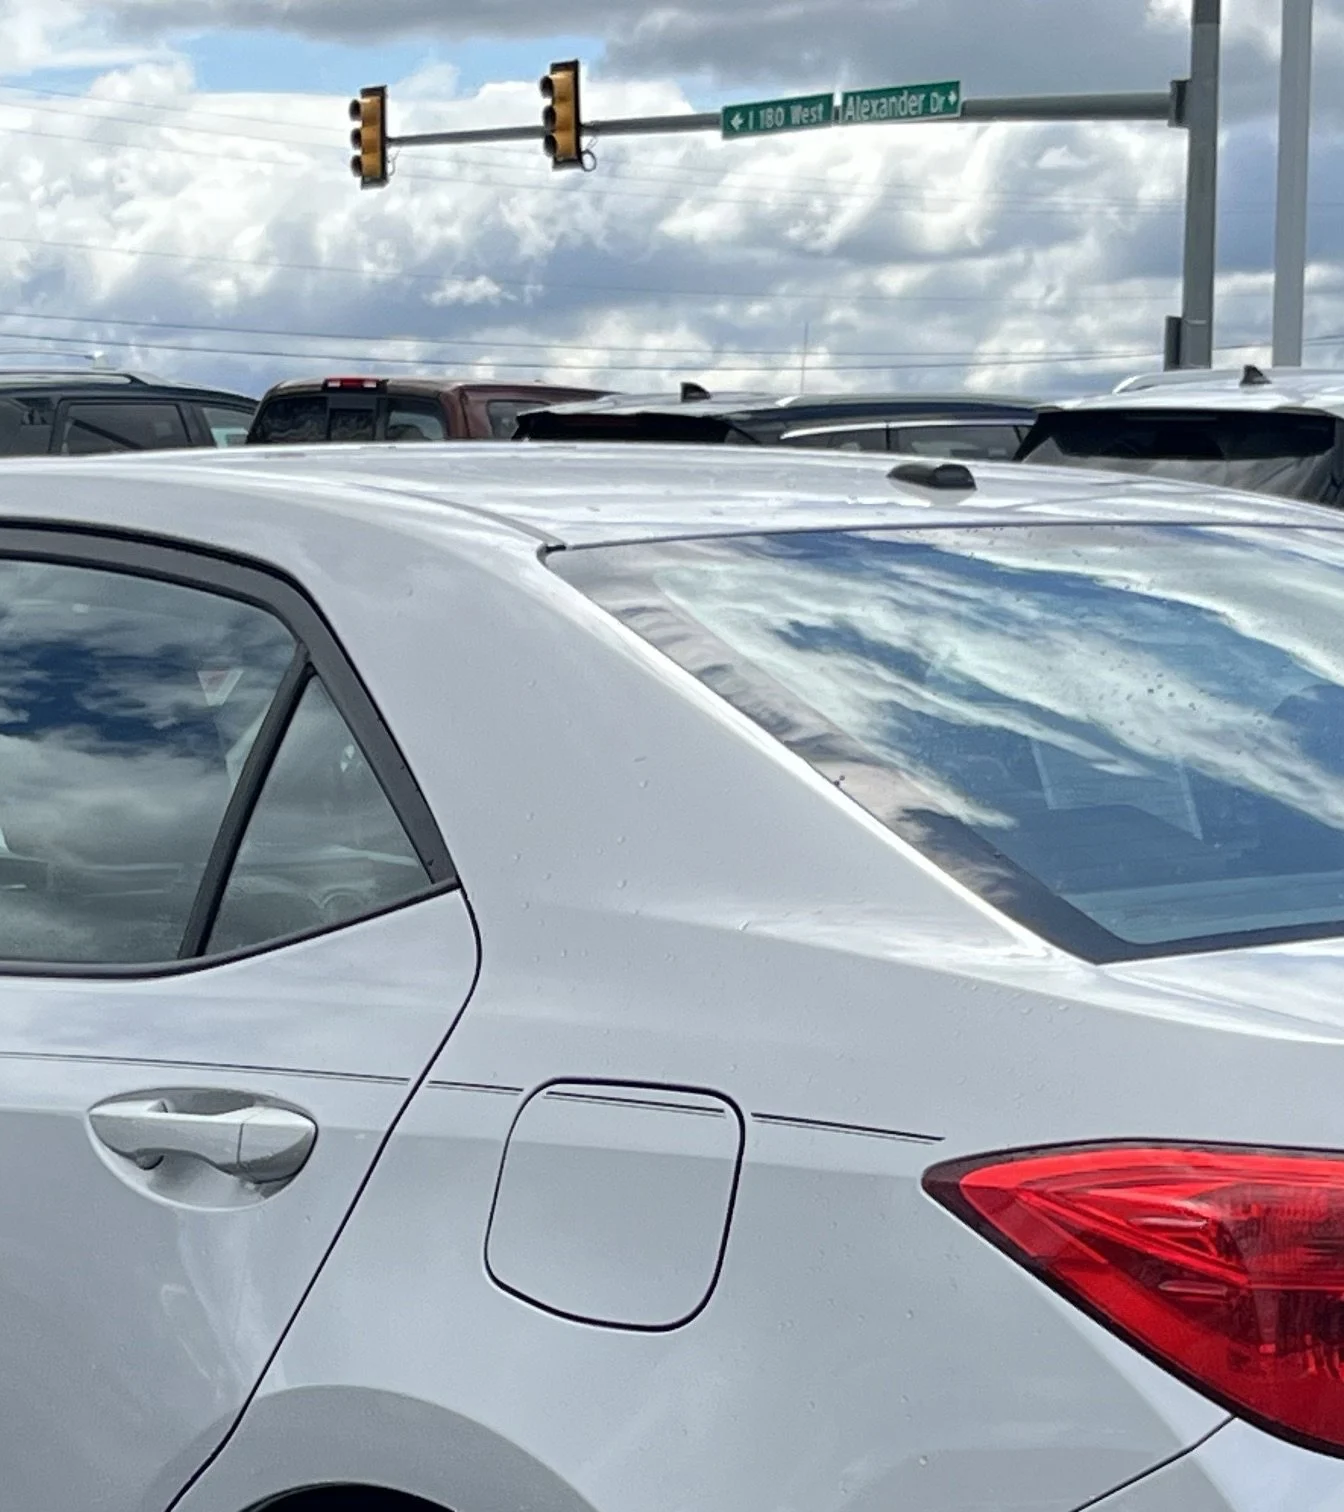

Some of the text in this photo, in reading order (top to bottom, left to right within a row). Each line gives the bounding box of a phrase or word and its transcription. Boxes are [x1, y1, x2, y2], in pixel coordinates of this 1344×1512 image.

[759, 107, 784, 128] 180
[790, 101, 825, 124] West
[845, 90, 945, 120] Alexander Dr
